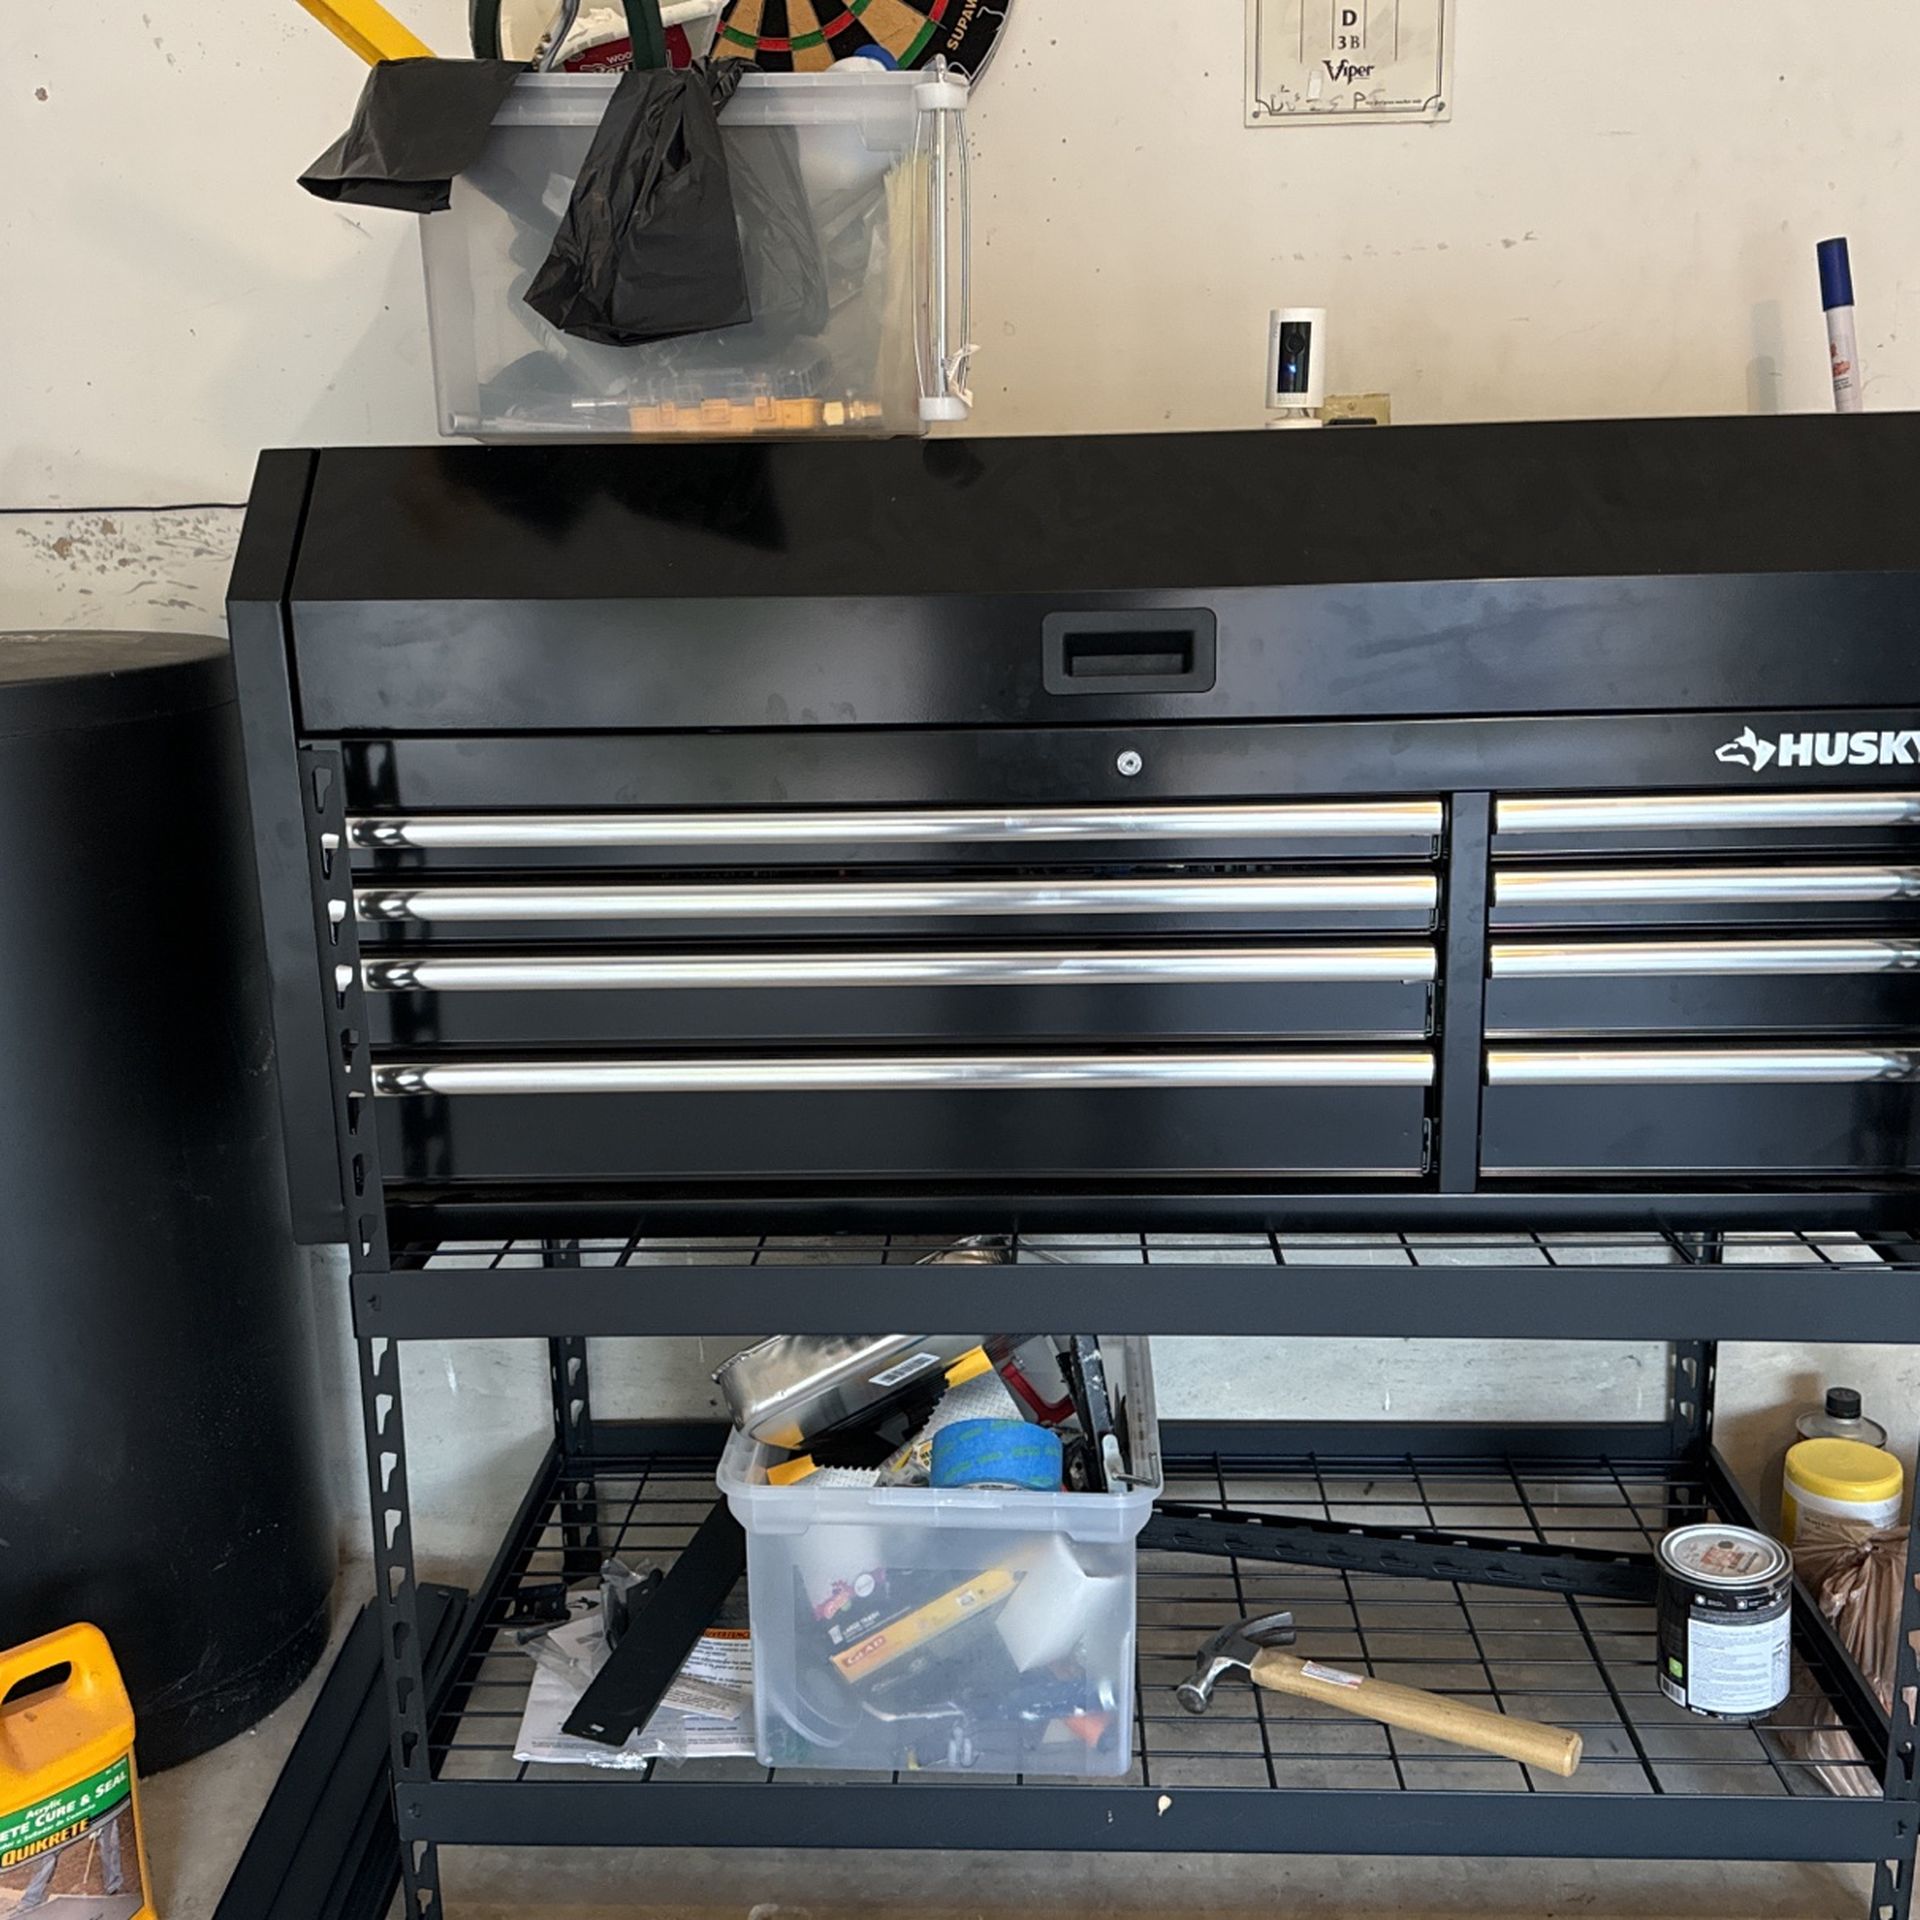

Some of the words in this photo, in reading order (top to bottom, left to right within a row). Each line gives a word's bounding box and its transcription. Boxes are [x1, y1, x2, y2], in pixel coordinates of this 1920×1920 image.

[1342, 9, 1357, 26] D
[606, 51, 633, 64] WOO
[1322, 59, 1375, 85] Viper
[846, 1636, 885, 1666] GLAD
[25, 1798, 62, 1820] Acrylic
[35, 1800, 76, 1827] CURE
[80, 1794, 90, 1807] &
[95, 1771, 127, 1799] SEAL
[1, 1817, 90, 1868] QUIKRETE
